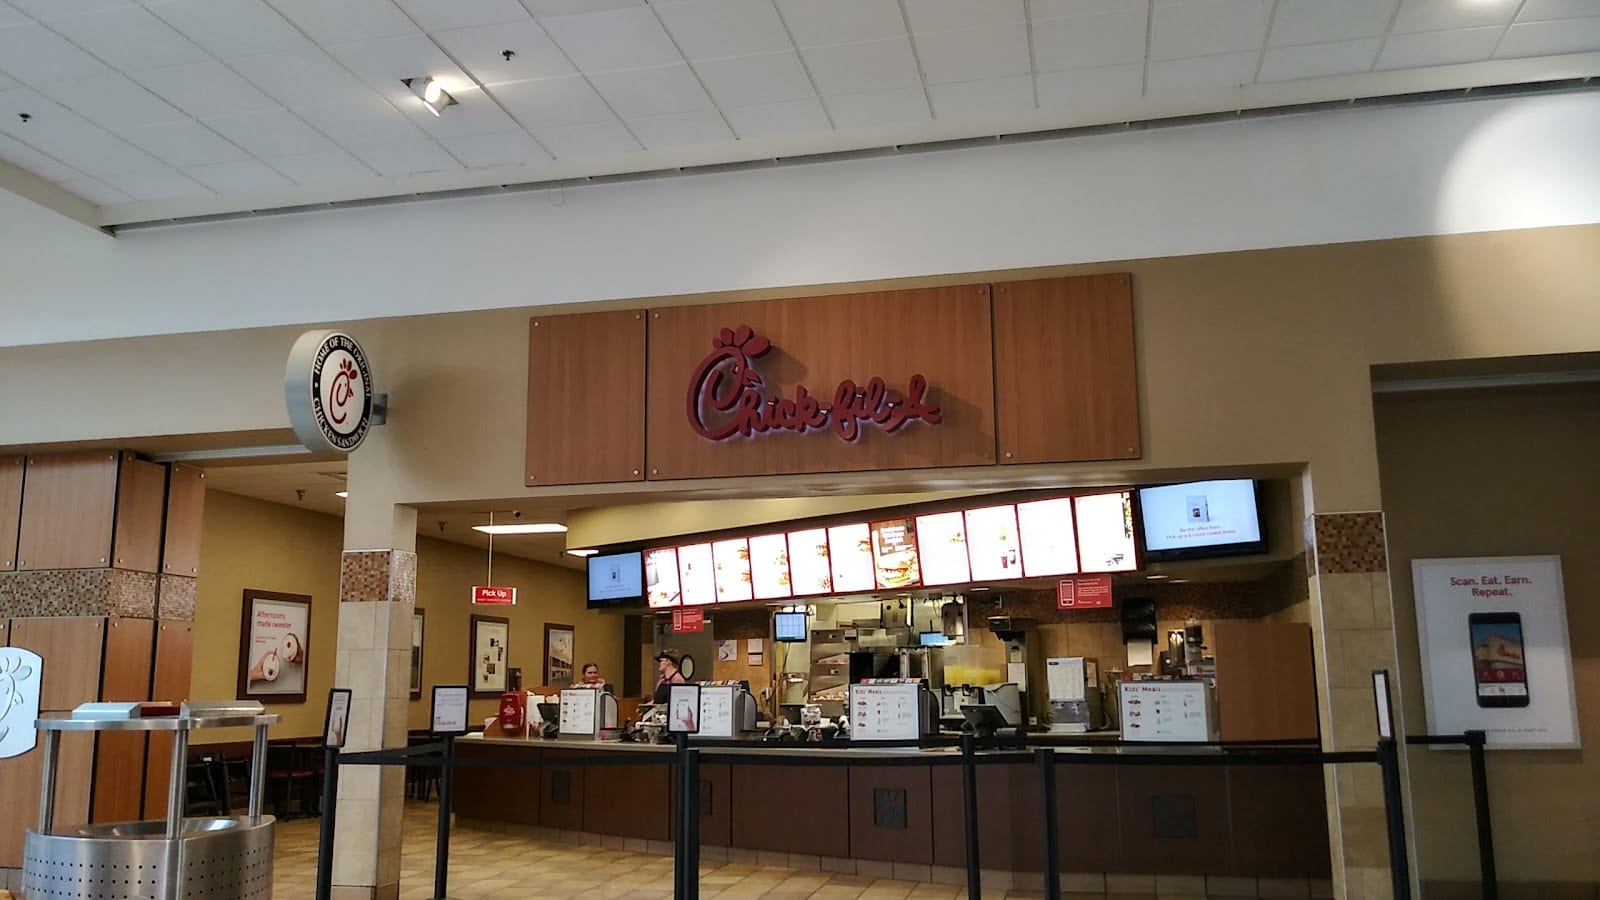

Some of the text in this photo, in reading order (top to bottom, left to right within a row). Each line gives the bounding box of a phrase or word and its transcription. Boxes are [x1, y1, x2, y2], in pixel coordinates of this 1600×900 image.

[314, 337, 371, 397] HOME OF THE ORIGINAL
[686, 324, 943, 442] Chick-fil-A
[313, 397, 368, 447] CHICKEN SANDWICH
[482, 589, 507, 598] Pick Up
[1450, 575, 1532, 586] Scan. Eat. Earn.
[1472, 587, 1512, 598] Repeat.
